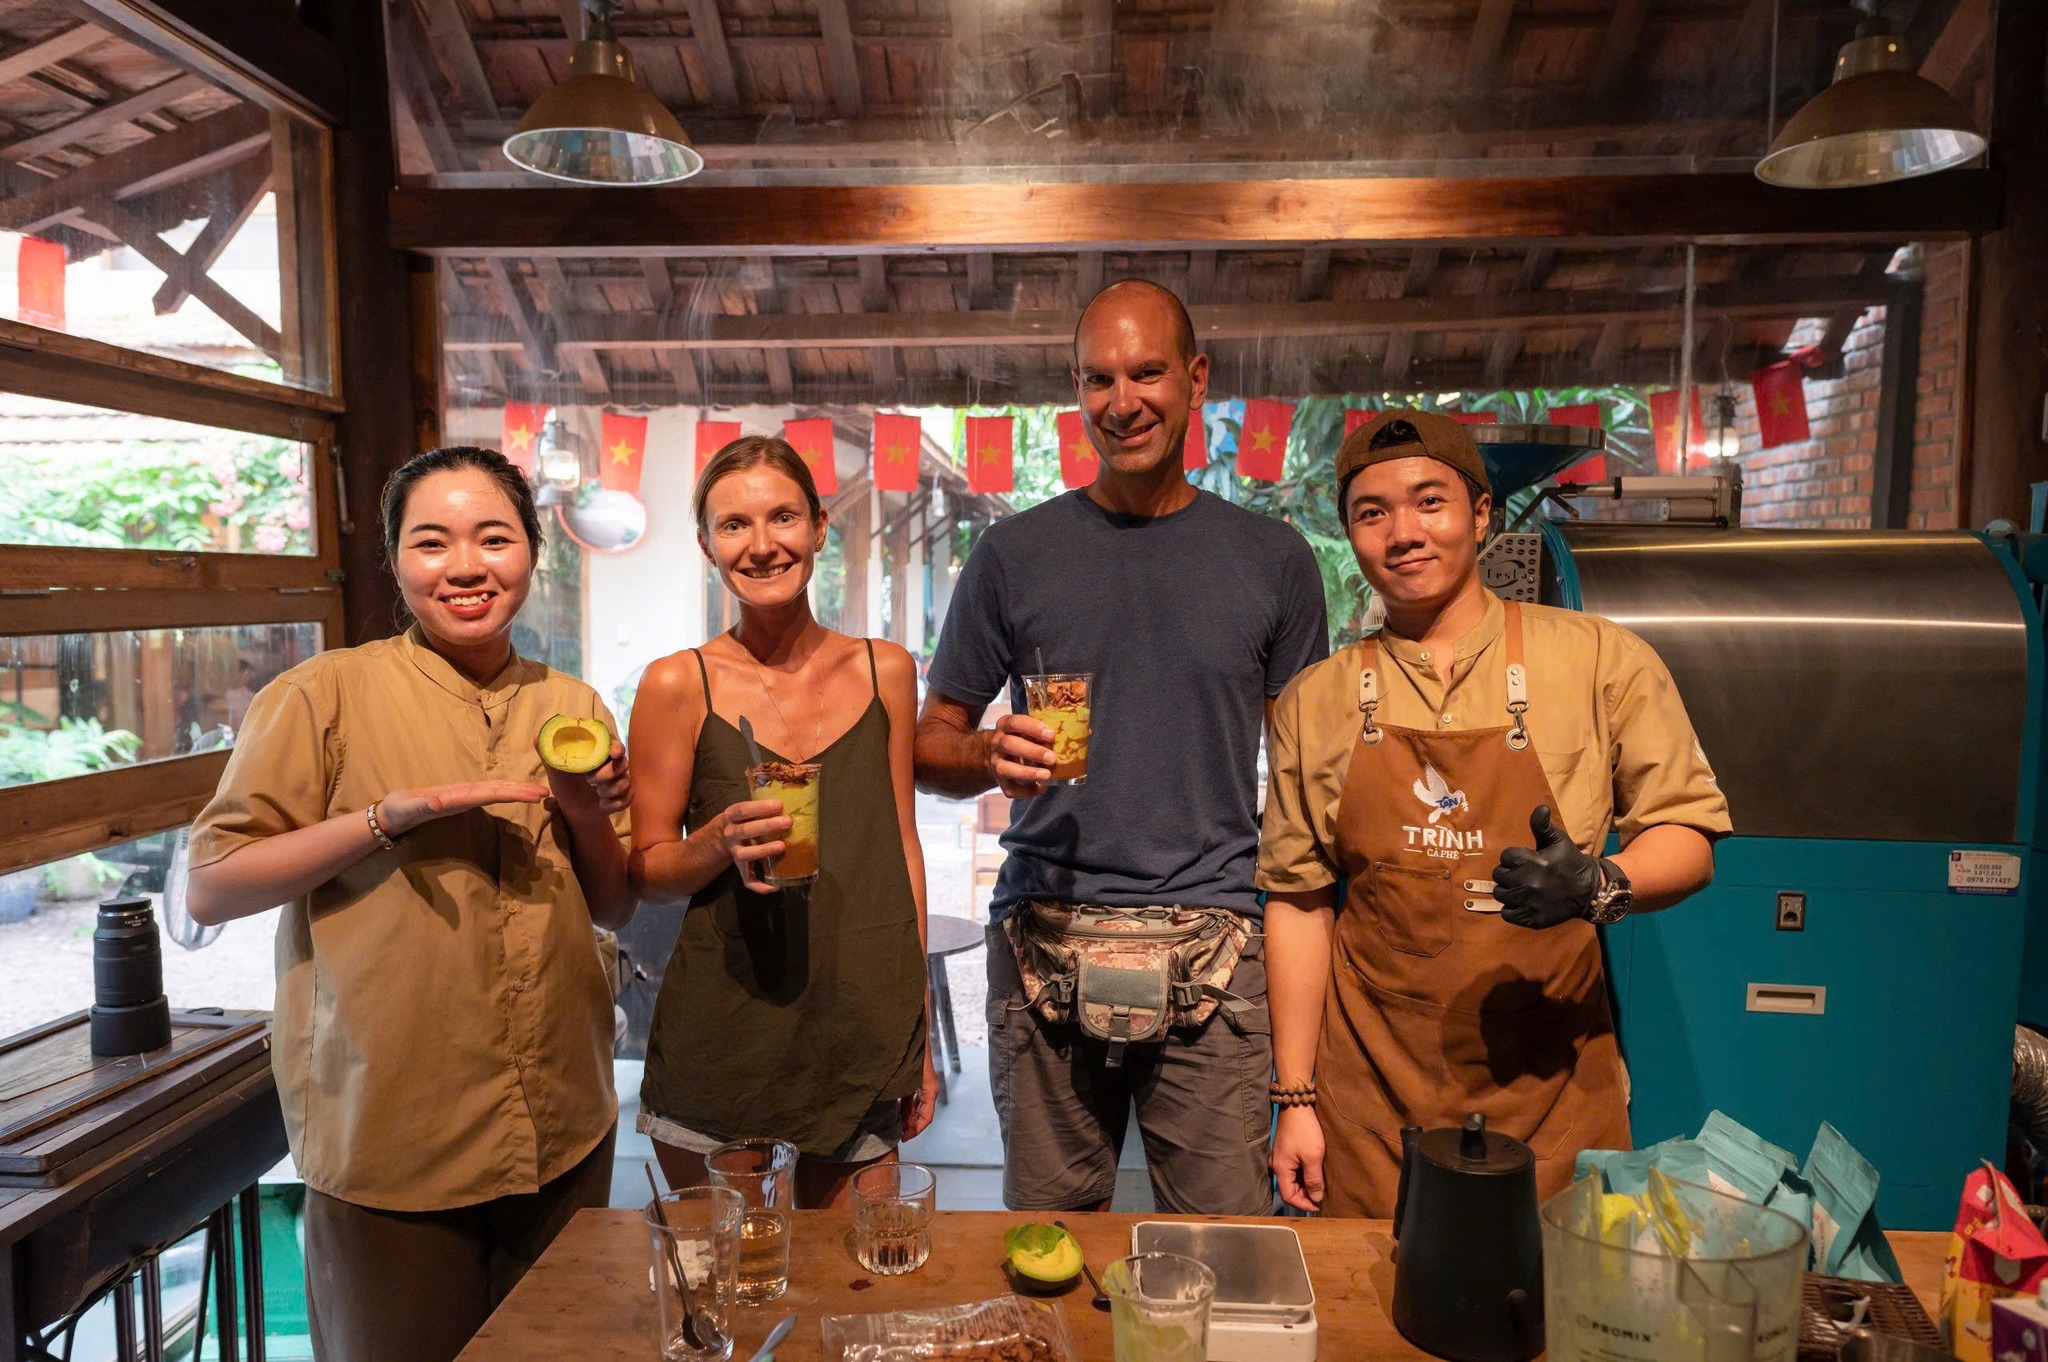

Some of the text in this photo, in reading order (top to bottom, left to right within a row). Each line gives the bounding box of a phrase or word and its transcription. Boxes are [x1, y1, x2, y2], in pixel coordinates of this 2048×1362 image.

[1402, 825, 1483, 850] TRÌNH
[1440, 849, 1460, 860] PHÊ
[1591, 1322, 1652, 1343] PROMIX
